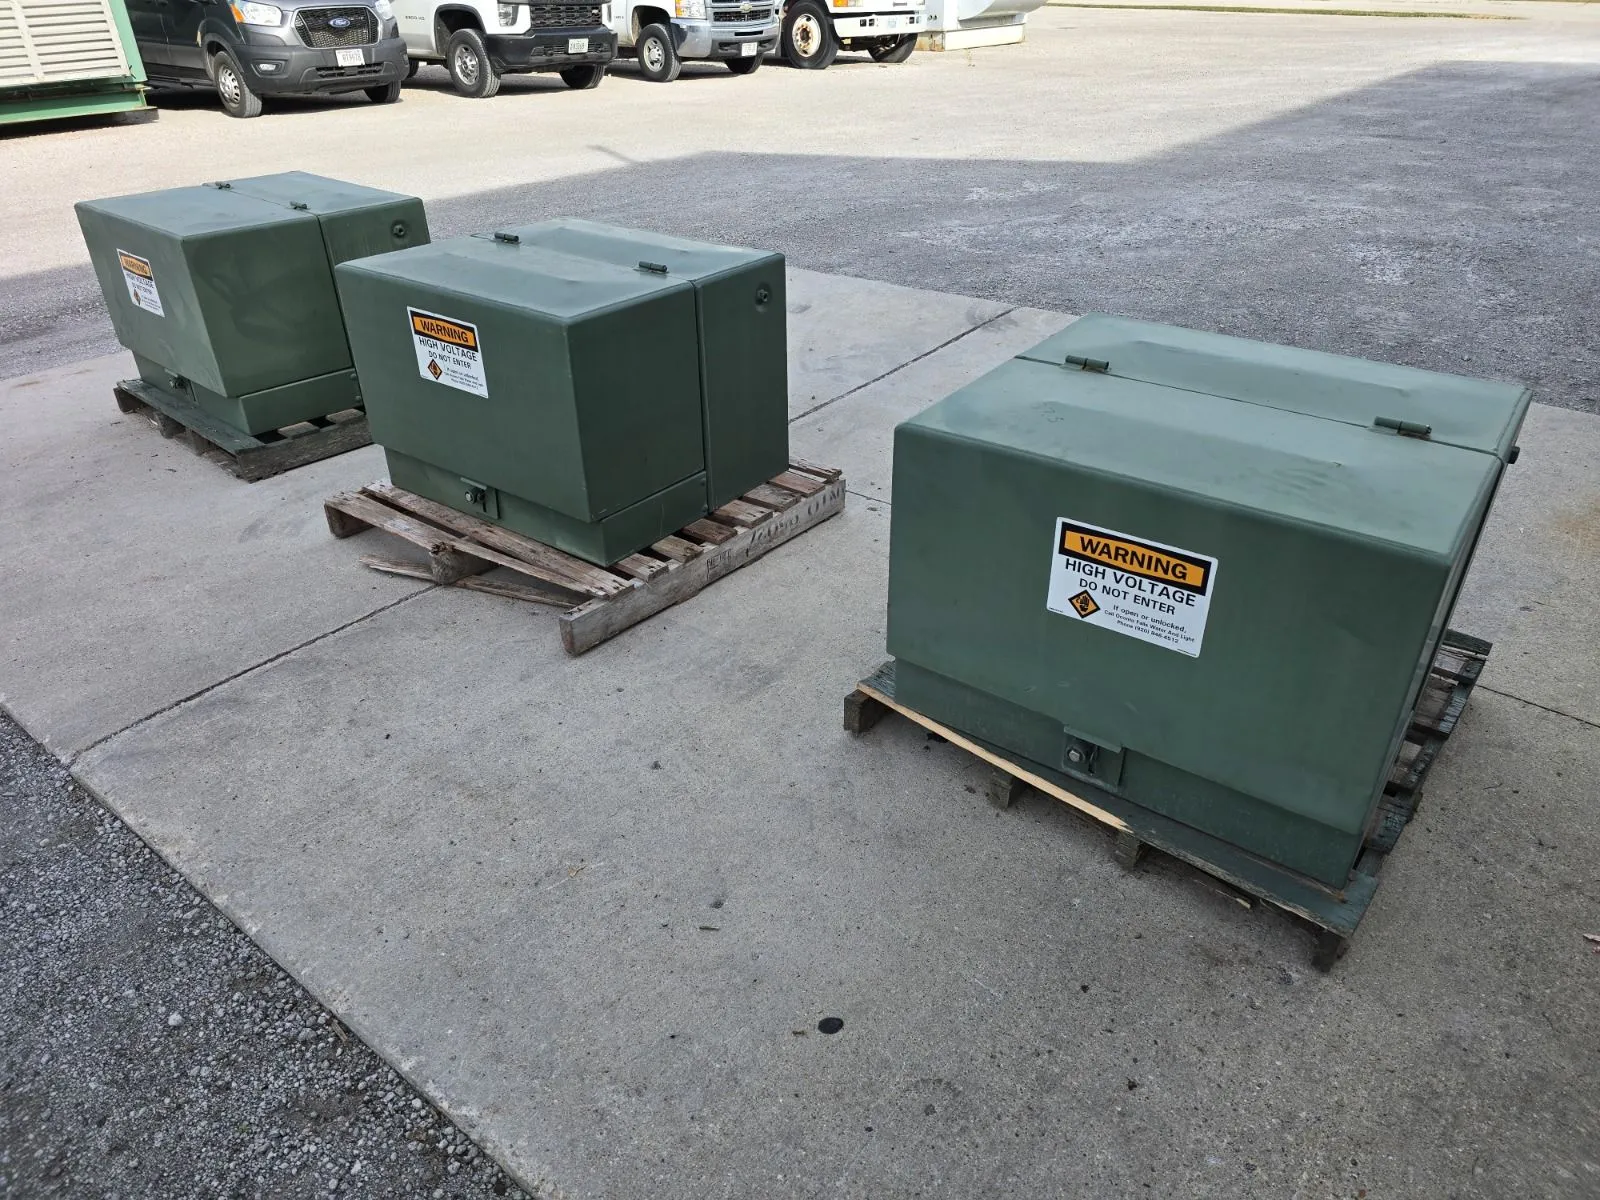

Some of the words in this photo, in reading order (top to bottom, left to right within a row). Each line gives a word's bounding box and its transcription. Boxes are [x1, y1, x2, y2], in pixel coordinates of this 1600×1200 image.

[420, 319, 468, 343] WARNING
[418, 336, 438, 350] HIGH
[439, 343, 477, 361] VOLTAGE
[428, 350, 437, 359] DO
[438, 353, 451, 362] NOT
[452, 358, 471, 369] ENTER
[1078, 535, 1189, 580] WARNING
[1065, 557, 1106, 580] HIGH
[1111, 571, 1196, 607] VOLTAGE
[1079, 578, 1097, 591] DO
[1101, 584, 1129, 600] NOT
[1133, 594, 1176, 615] ENTER
[1119, 607, 1138, 620] open
